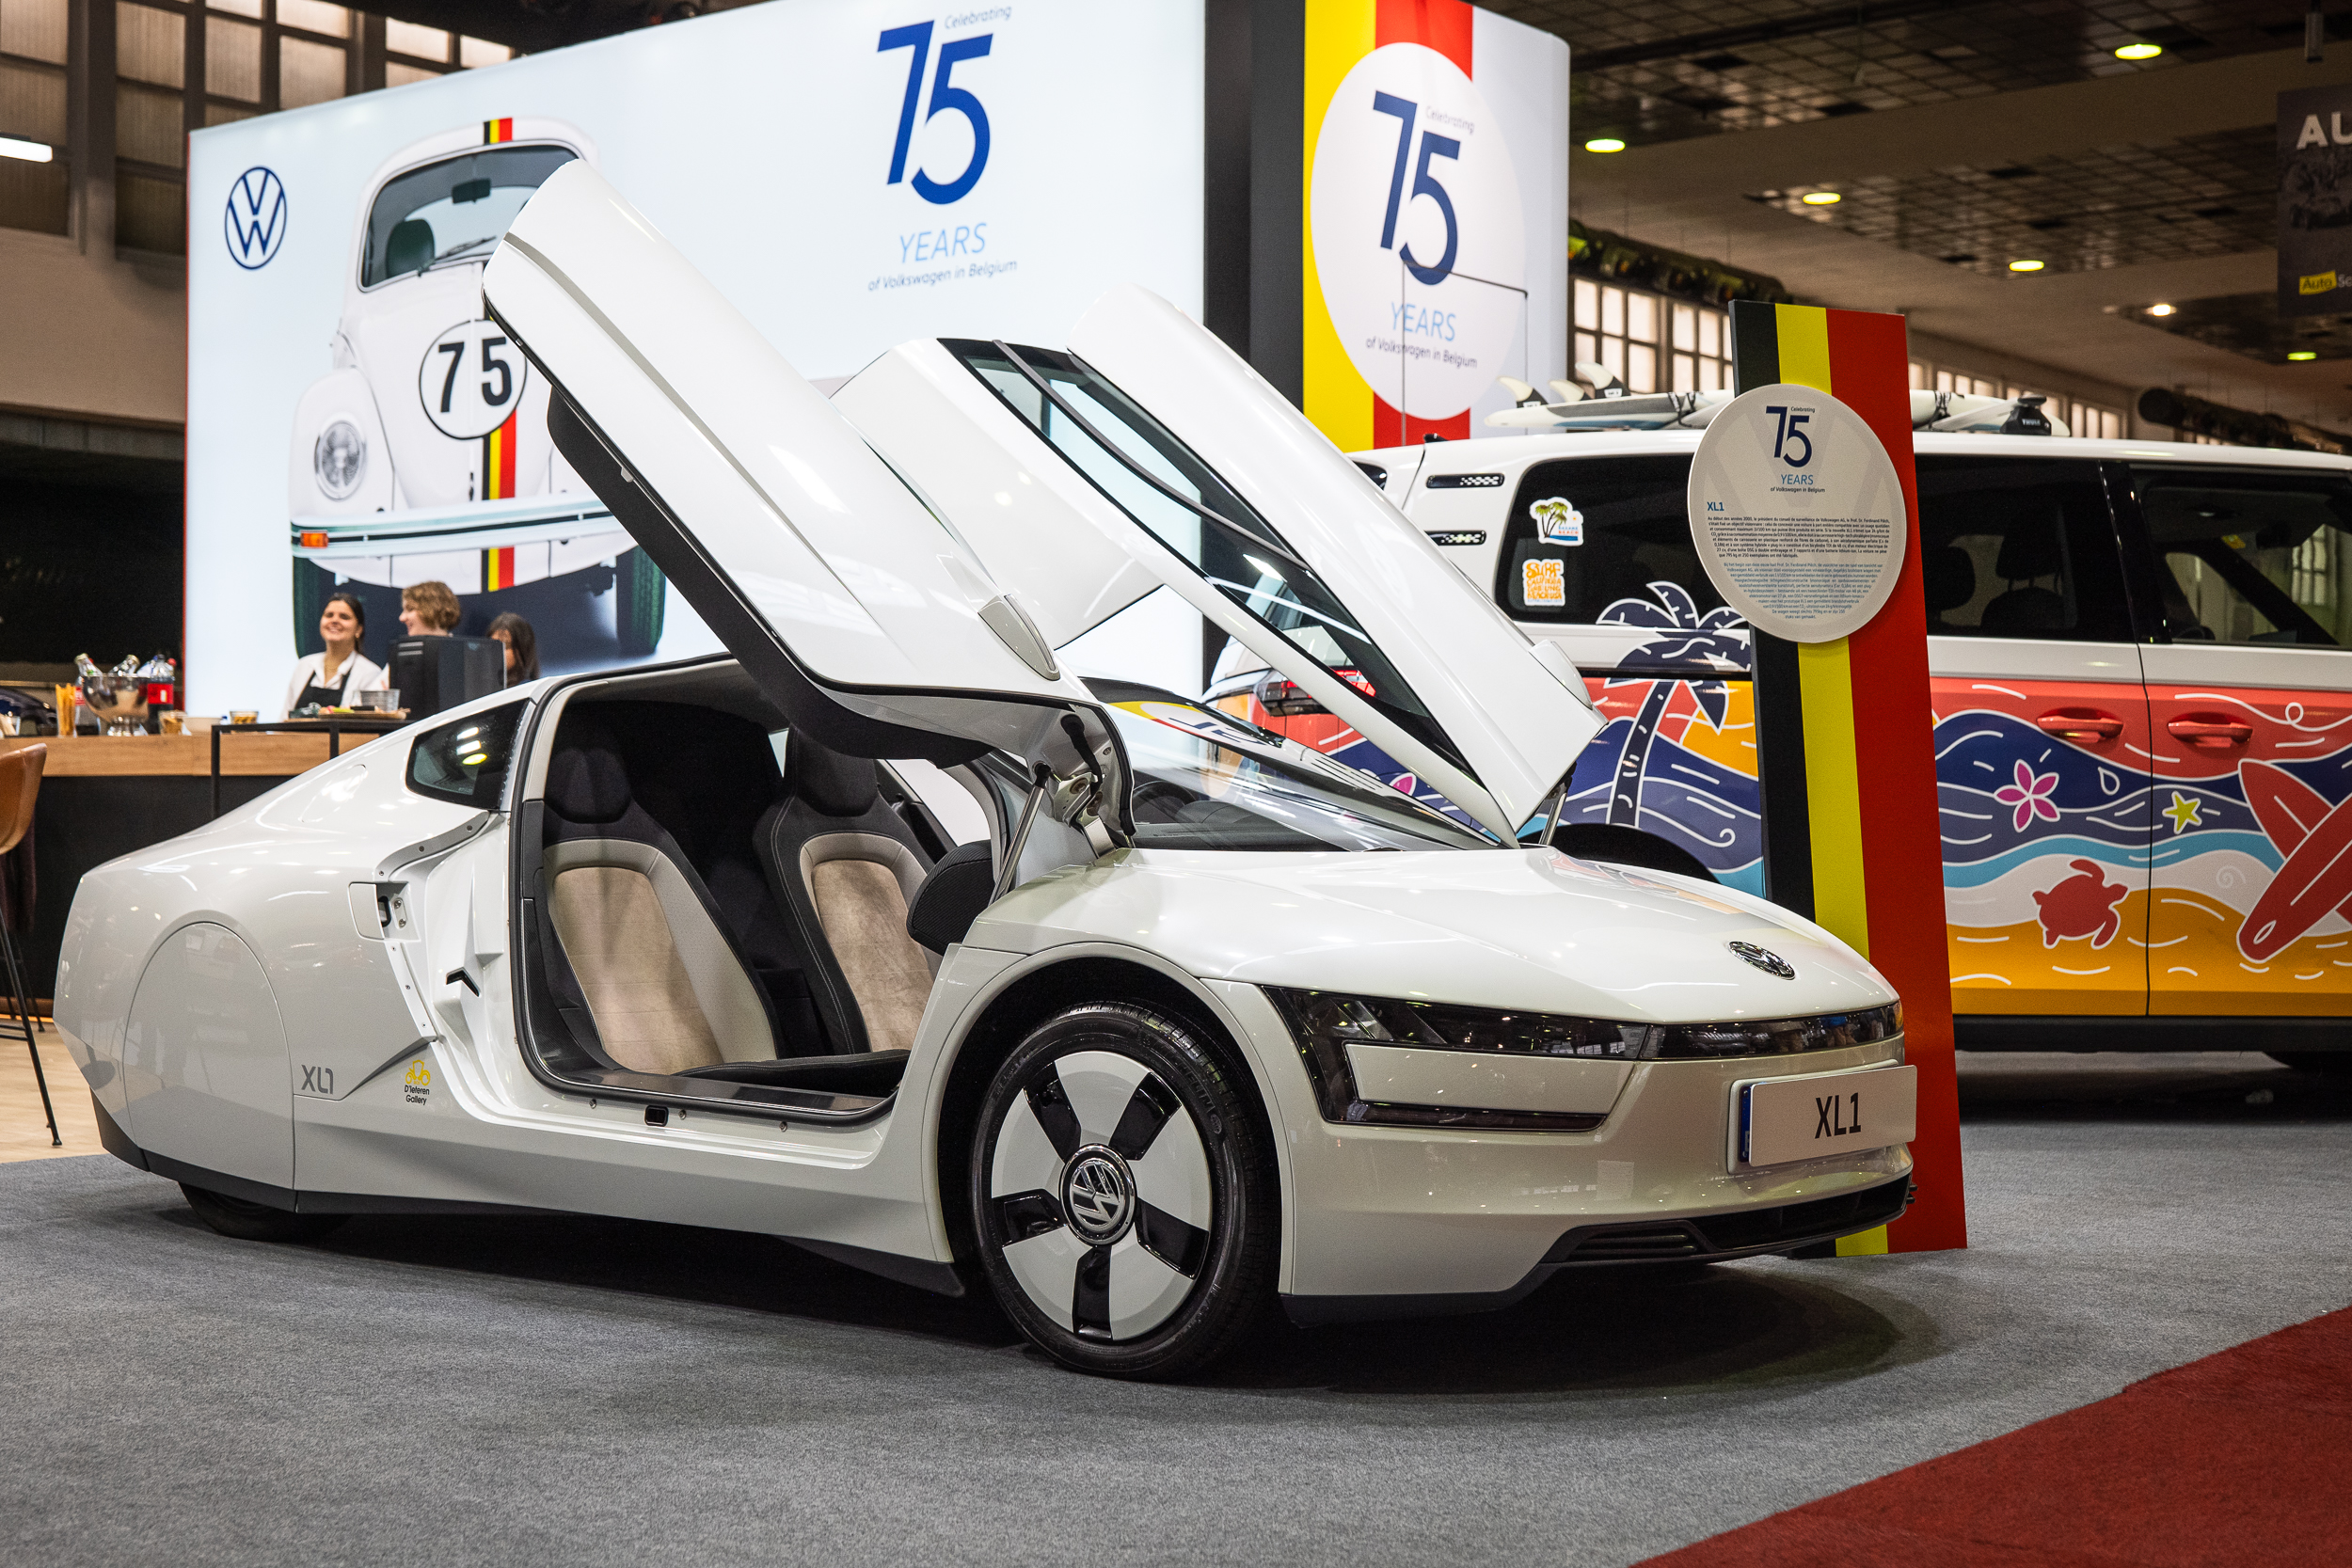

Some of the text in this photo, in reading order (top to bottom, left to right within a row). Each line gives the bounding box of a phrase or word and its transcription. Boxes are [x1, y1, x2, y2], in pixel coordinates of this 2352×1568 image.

[945, 6, 1012, 29] Celebrating
[877, 20, 993, 205] 75
[1425, 105, 1475, 135] Celebrating
[1373, 90, 1461, 285] 75
[899, 222, 988, 263] YEARS
[867, 260, 1018, 292] of Volkswagen in Belgium
[1391, 301, 1456, 341] YEARS
[1366, 336, 1478, 370] of Volkswagen in Belgium
[1766, 405, 1813, 467] 75
[1781, 474, 1814, 485] YEARS
[1707, 501, 1724, 511] XL1
[1526, 562, 1561, 578] SURF
[301, 1064, 334, 1095] XL1
[406, 1094, 427, 1106] Gallery
[1815, 1092, 1862, 1139] XL1
